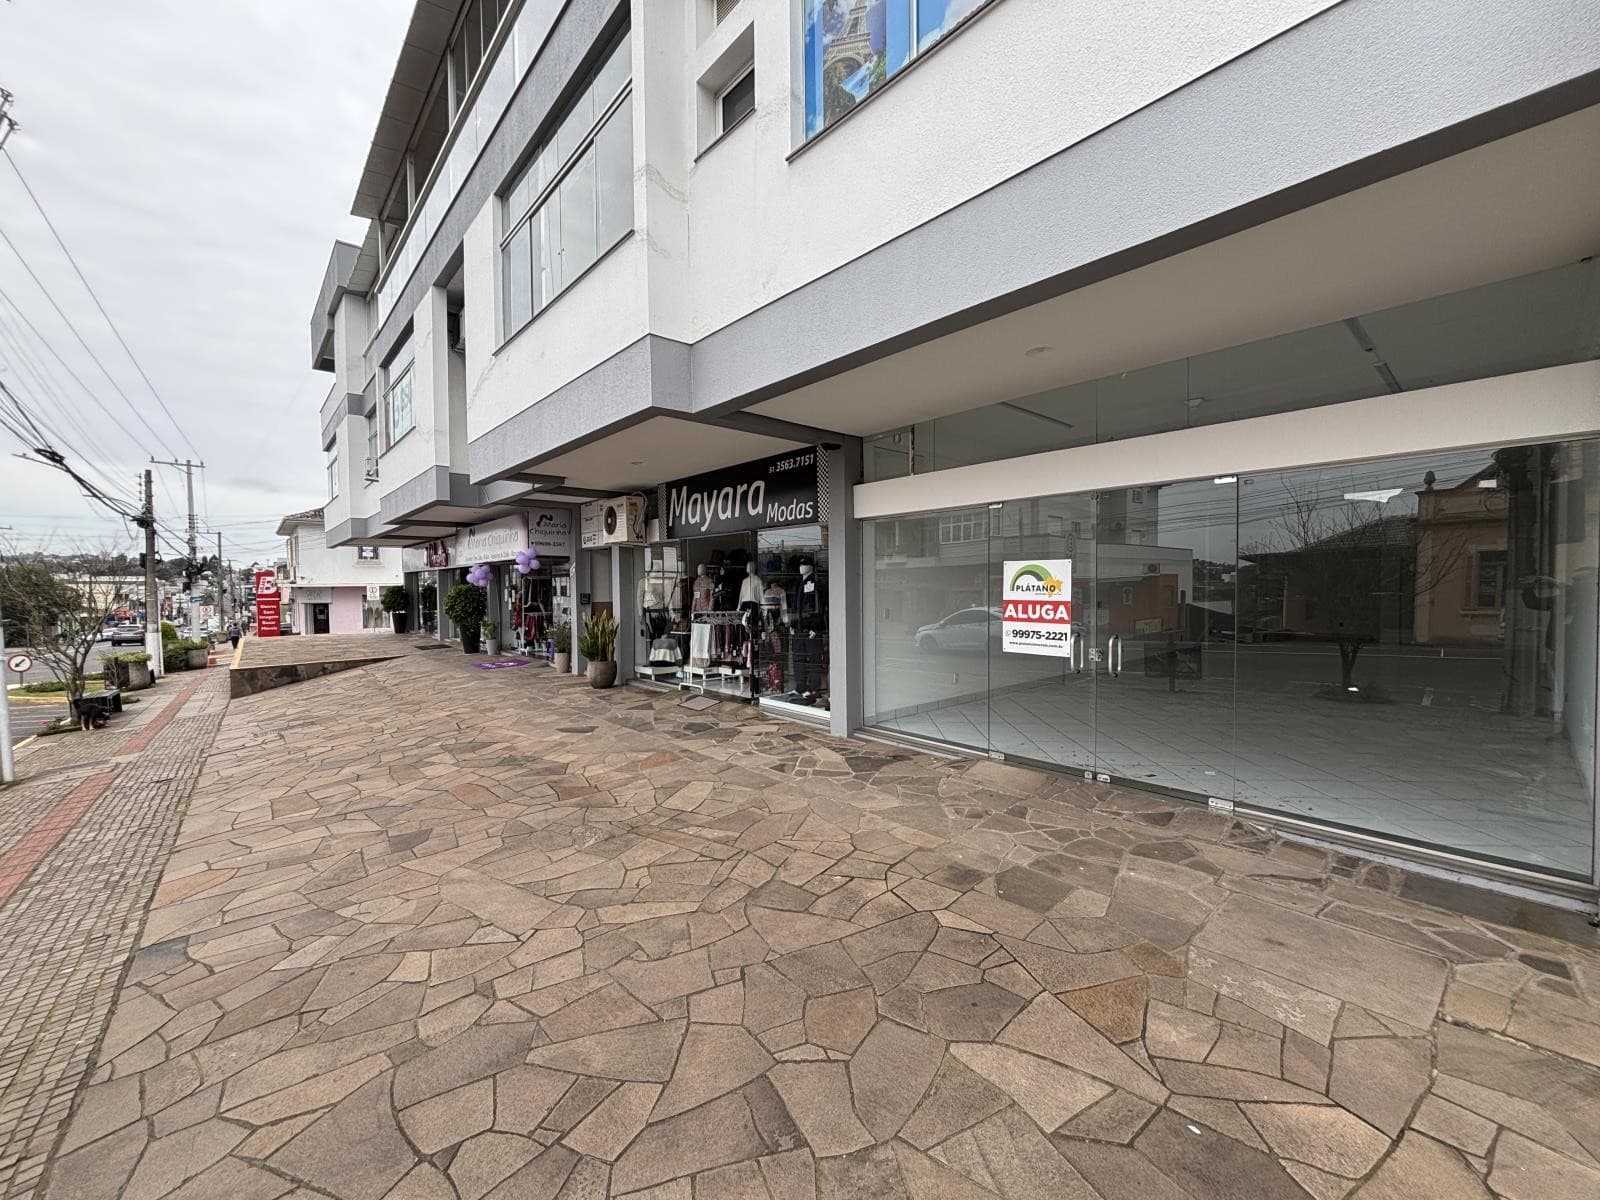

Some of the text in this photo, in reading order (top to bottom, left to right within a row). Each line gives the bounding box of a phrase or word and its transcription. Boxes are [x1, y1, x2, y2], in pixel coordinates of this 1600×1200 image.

[775, 454, 814, 472] 3563.7151
[669, 480, 766, 532] Mayara
[766, 499, 813, 523] Modas
[1015, 583, 1056, 593] PLÁTANO
[1004, 603, 1069, 620] ALUGA
[1012, 629, 1068, 641] 99975-2221
